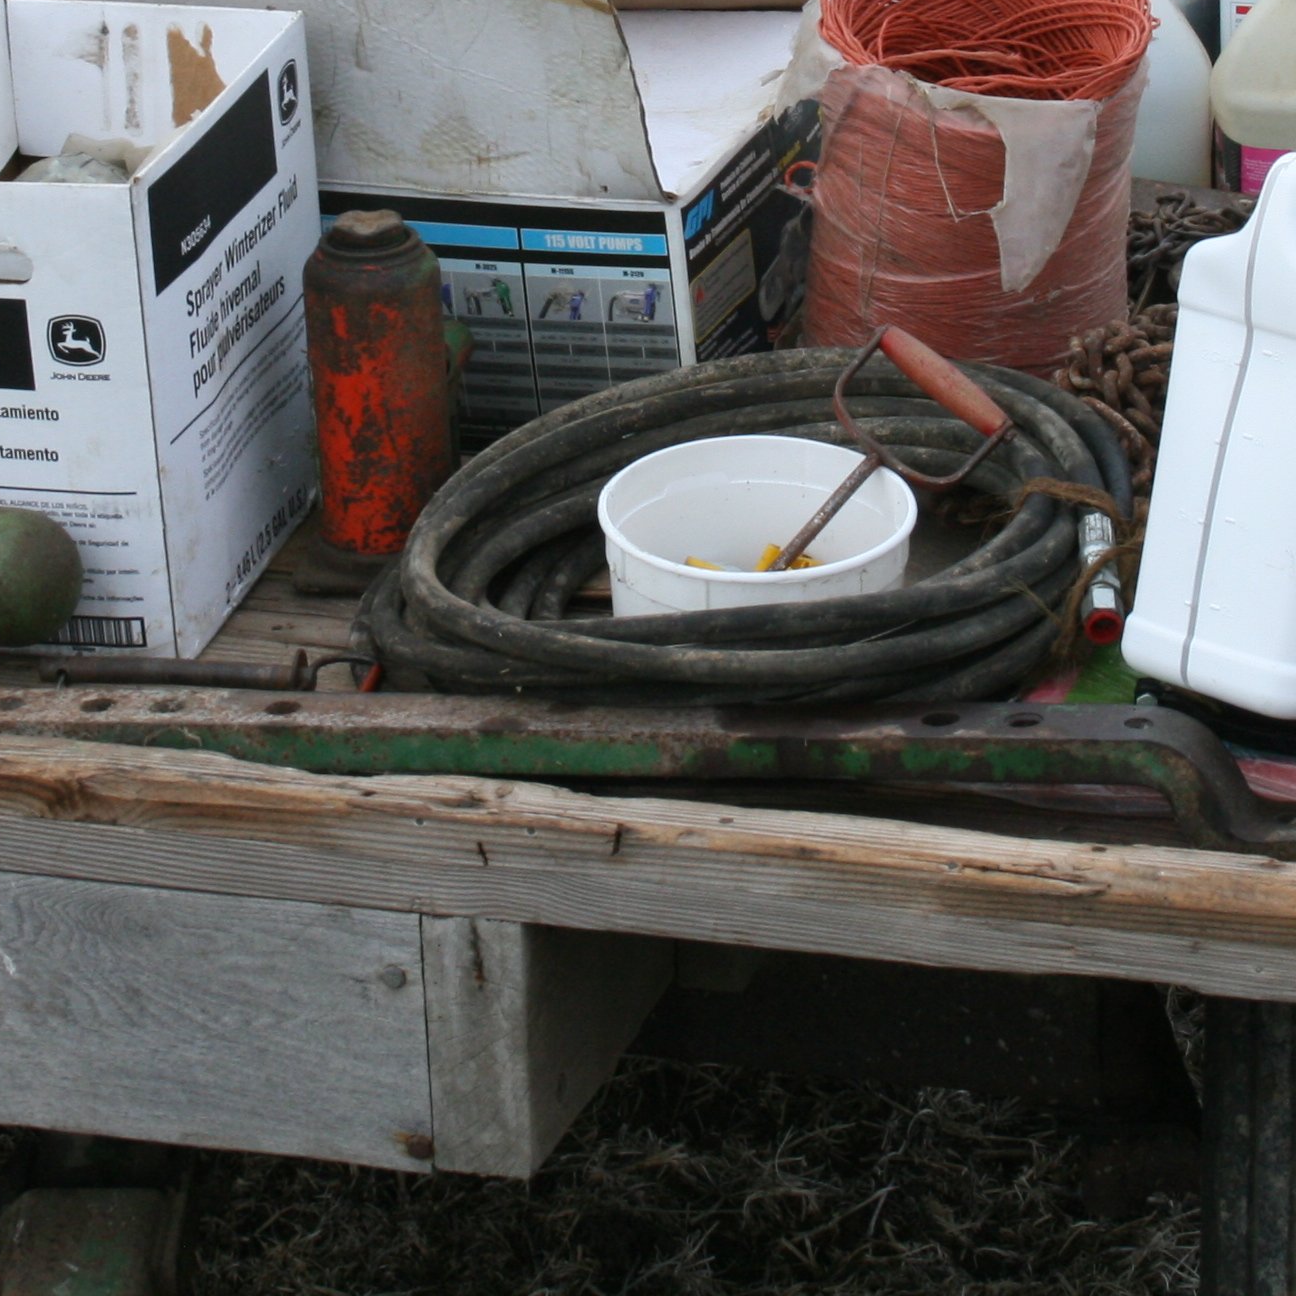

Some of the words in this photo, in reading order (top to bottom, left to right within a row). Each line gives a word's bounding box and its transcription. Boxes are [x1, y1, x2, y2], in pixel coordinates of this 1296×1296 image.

[180, 214, 212, 257] N305634
[186, 253, 224, 317] Sprayer
[224, 212, 277, 273] Winterizer
[278, 174, 298, 220] Fluid
[544, 234, 565, 248] 115
[568, 234, 598, 250] VOLT
[599, 235, 644, 252] PUMPS
[189, 308, 220, 359] Fluide
[220, 260, 262, 328] hivernal
[192, 353, 217, 399] pour
[217, 275, 286, 366] pulvérisateurs
[50, 371, 77, 381] JOHN
[77, 372, 111, 382] DEERE
